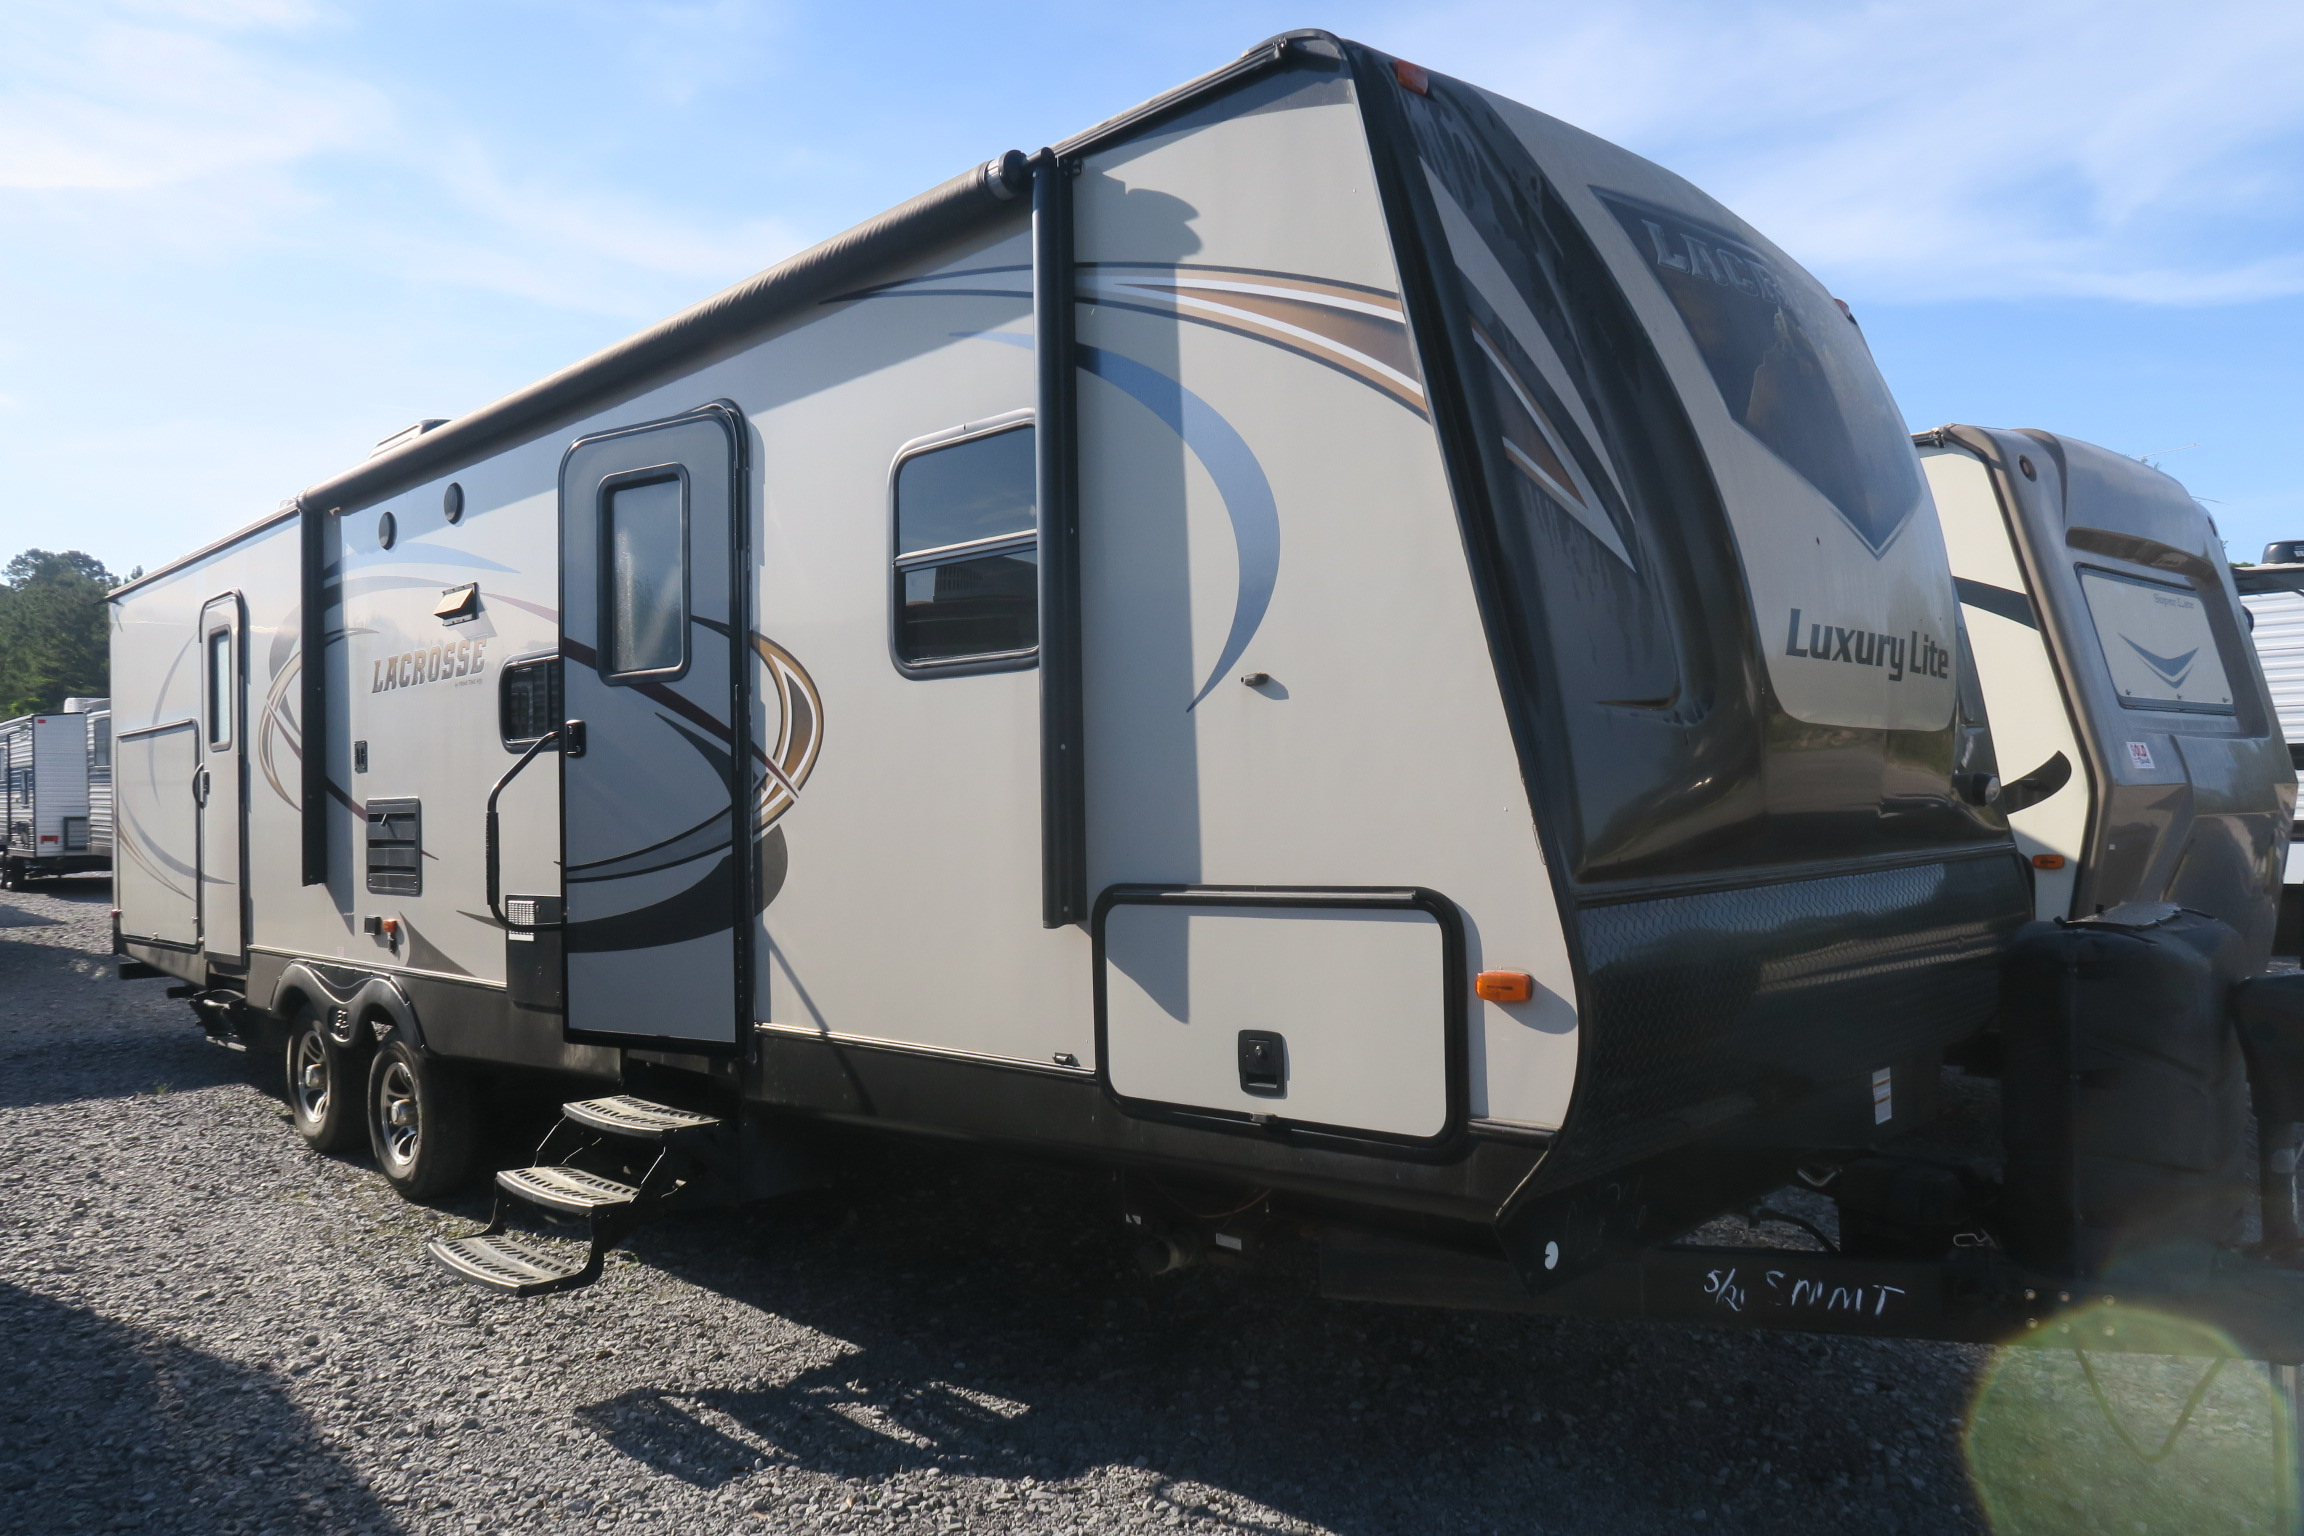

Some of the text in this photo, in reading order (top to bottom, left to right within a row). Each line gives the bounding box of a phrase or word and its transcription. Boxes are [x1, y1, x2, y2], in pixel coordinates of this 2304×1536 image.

[1640, 218, 1788, 307] LACR
[371, 636, 488, 694] LACROSSE
[1785, 607, 1949, 682] Luxury Lite
